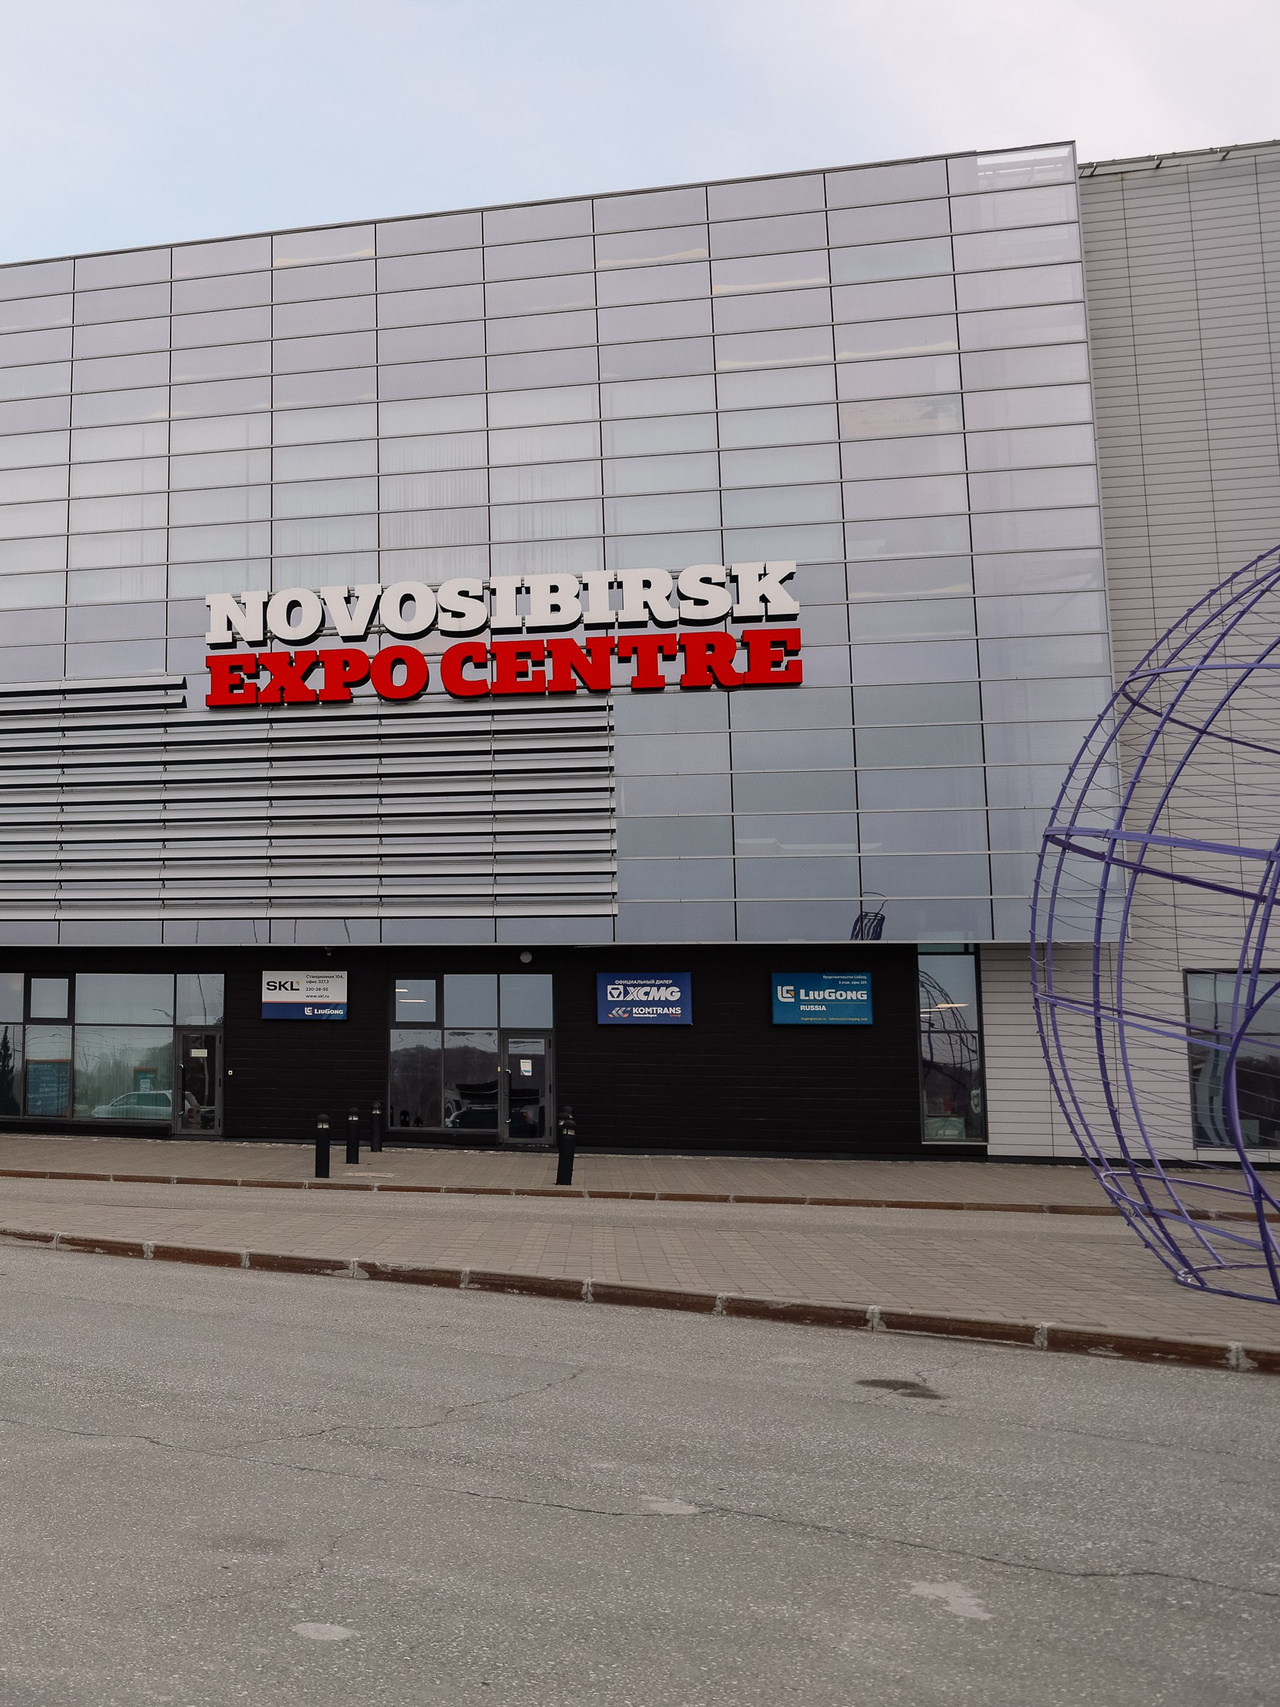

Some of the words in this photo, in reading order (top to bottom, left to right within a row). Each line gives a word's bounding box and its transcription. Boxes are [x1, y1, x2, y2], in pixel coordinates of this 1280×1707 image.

[205, 561, 800, 648] NOVOSIBIRSK
[205, 645, 429, 707] EXPO
[440, 628, 803, 698] CENTRE
[266, 980, 300, 991] SKL
[623, 986, 681, 1001] XCMG
